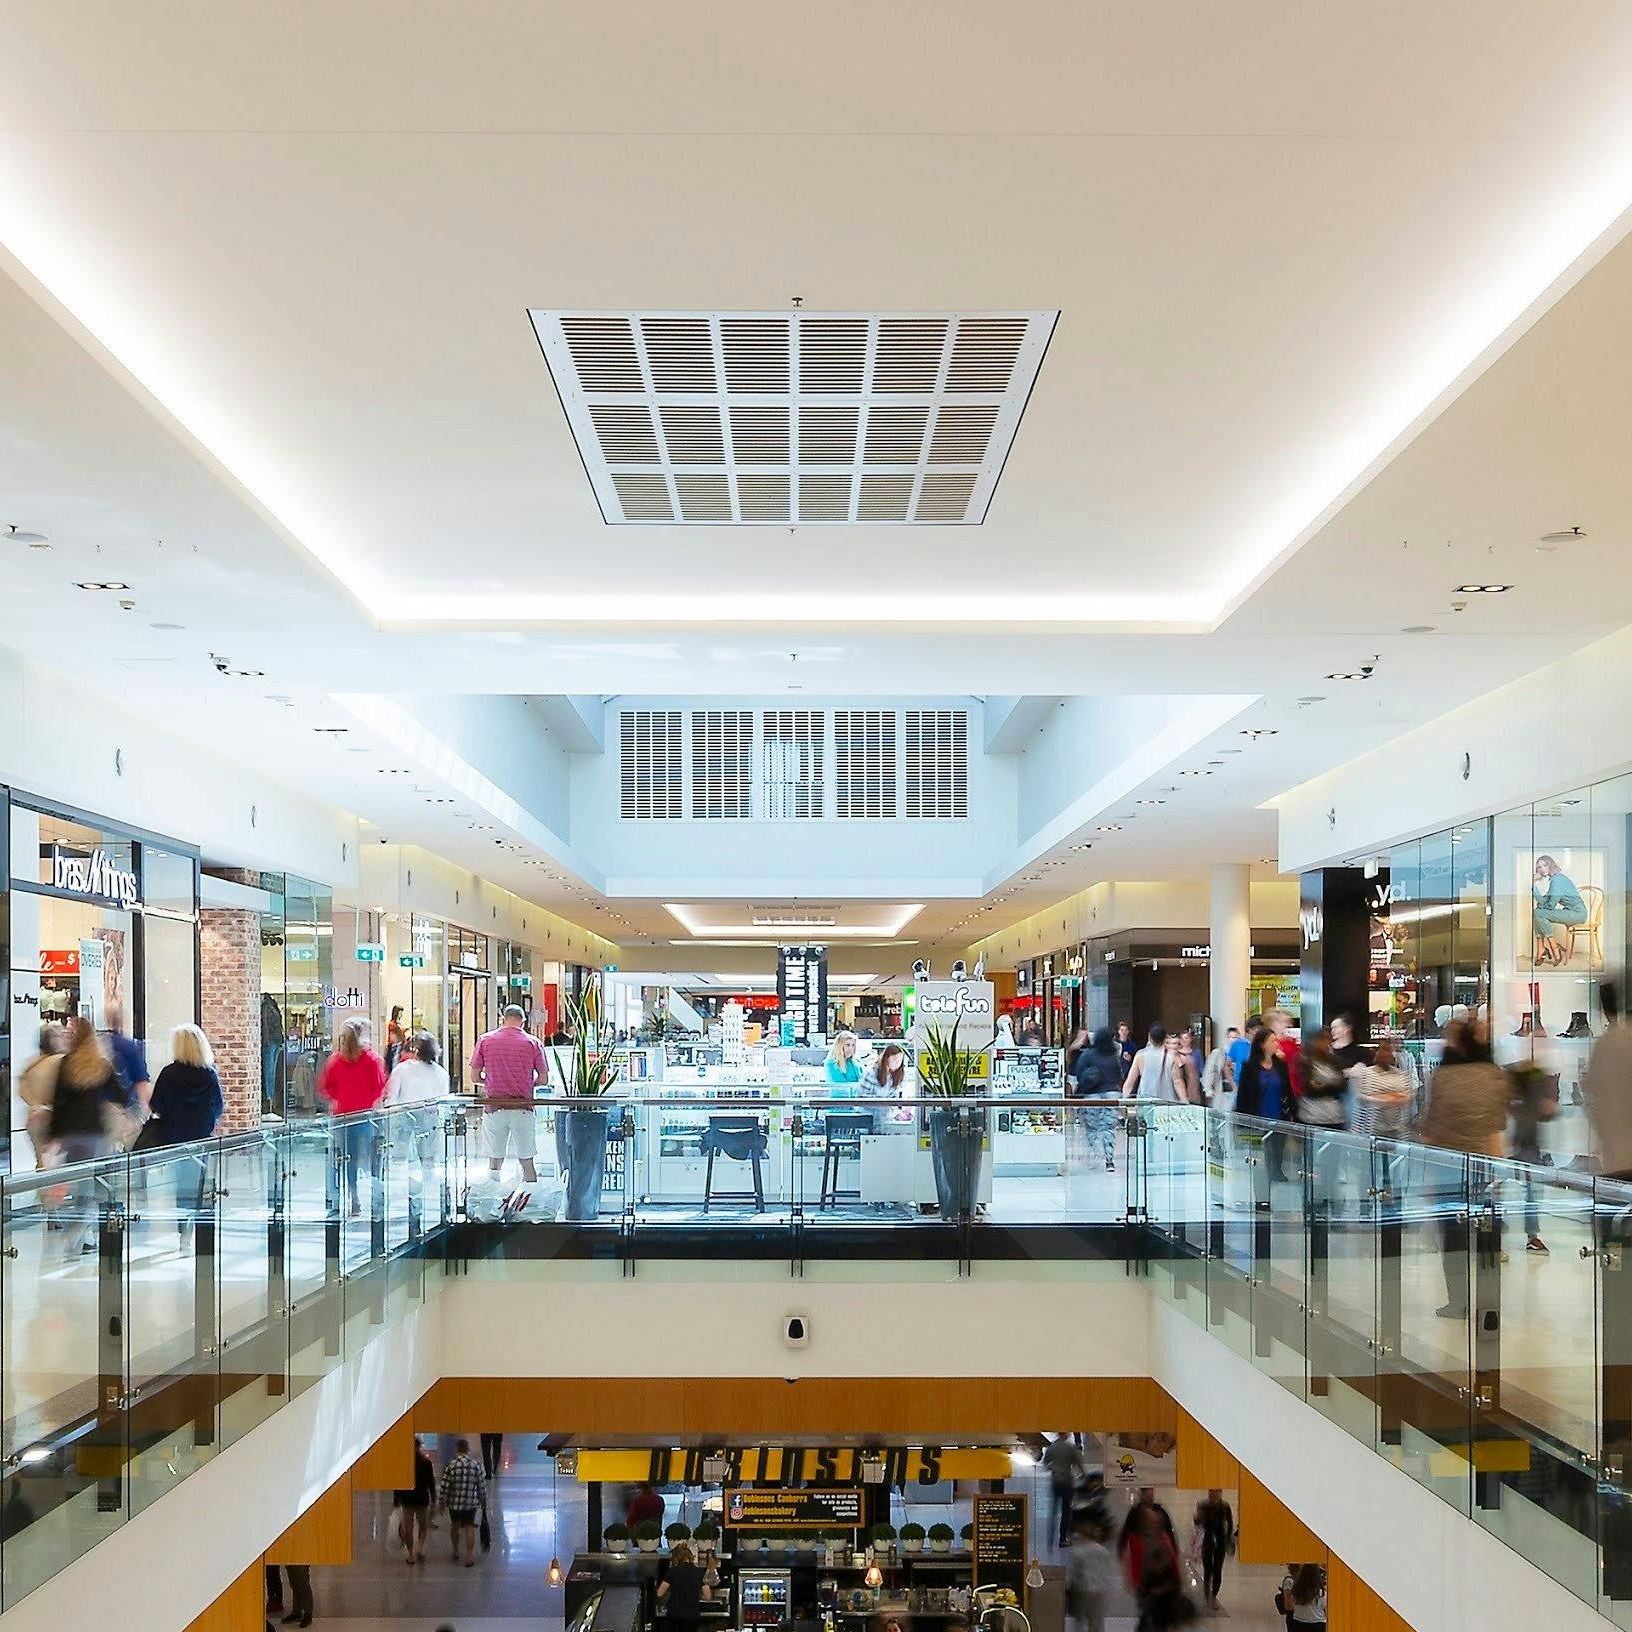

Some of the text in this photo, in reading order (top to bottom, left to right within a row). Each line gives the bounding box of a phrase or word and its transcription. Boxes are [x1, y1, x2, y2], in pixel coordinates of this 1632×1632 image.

[54, 844, 83, 889] bras
[102, 853, 137, 910] things
[1181, 945, 1211, 958] mich
[785, 956, 805, 998] TIME
[324, 987, 364, 1007] dotti
[920, 987, 990, 1016] telefun
[601, 1173, 624, 1190] RED
